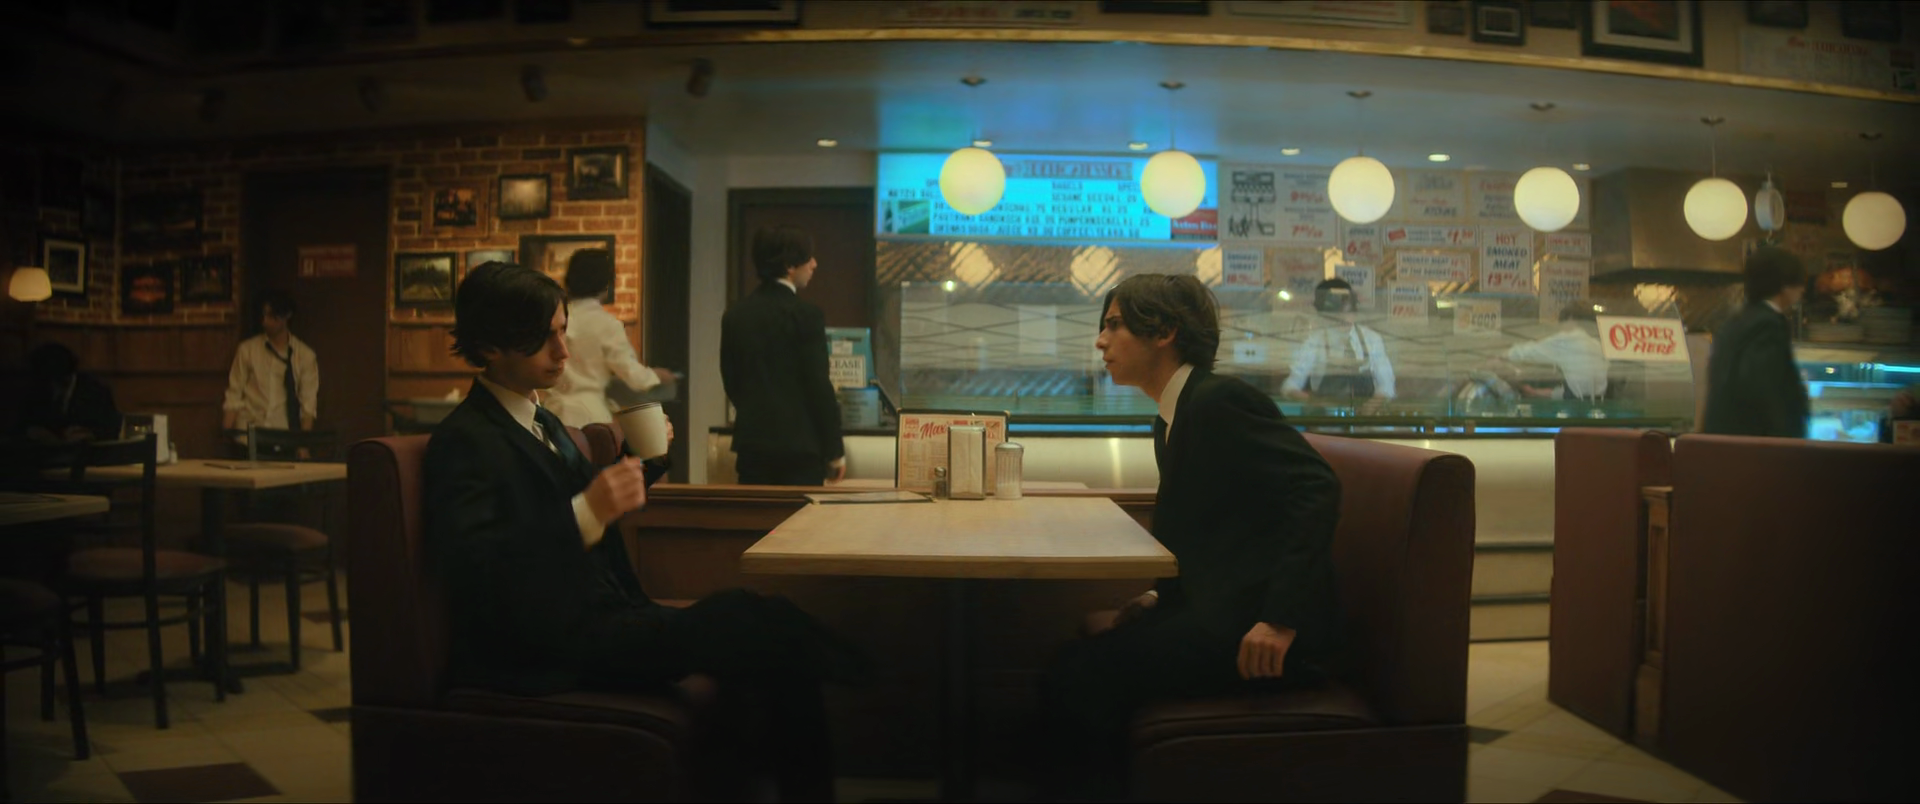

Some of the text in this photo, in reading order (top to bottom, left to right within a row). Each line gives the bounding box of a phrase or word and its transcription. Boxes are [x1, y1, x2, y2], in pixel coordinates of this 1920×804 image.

[1495, 231, 1518, 245] HOT
[1485, 246, 1529, 257] SMOKED
[1491, 259, 1520, 270] MEAT
[1609, 323, 1674, 351] ORDER
[1633, 342, 1677, 354] HERE
